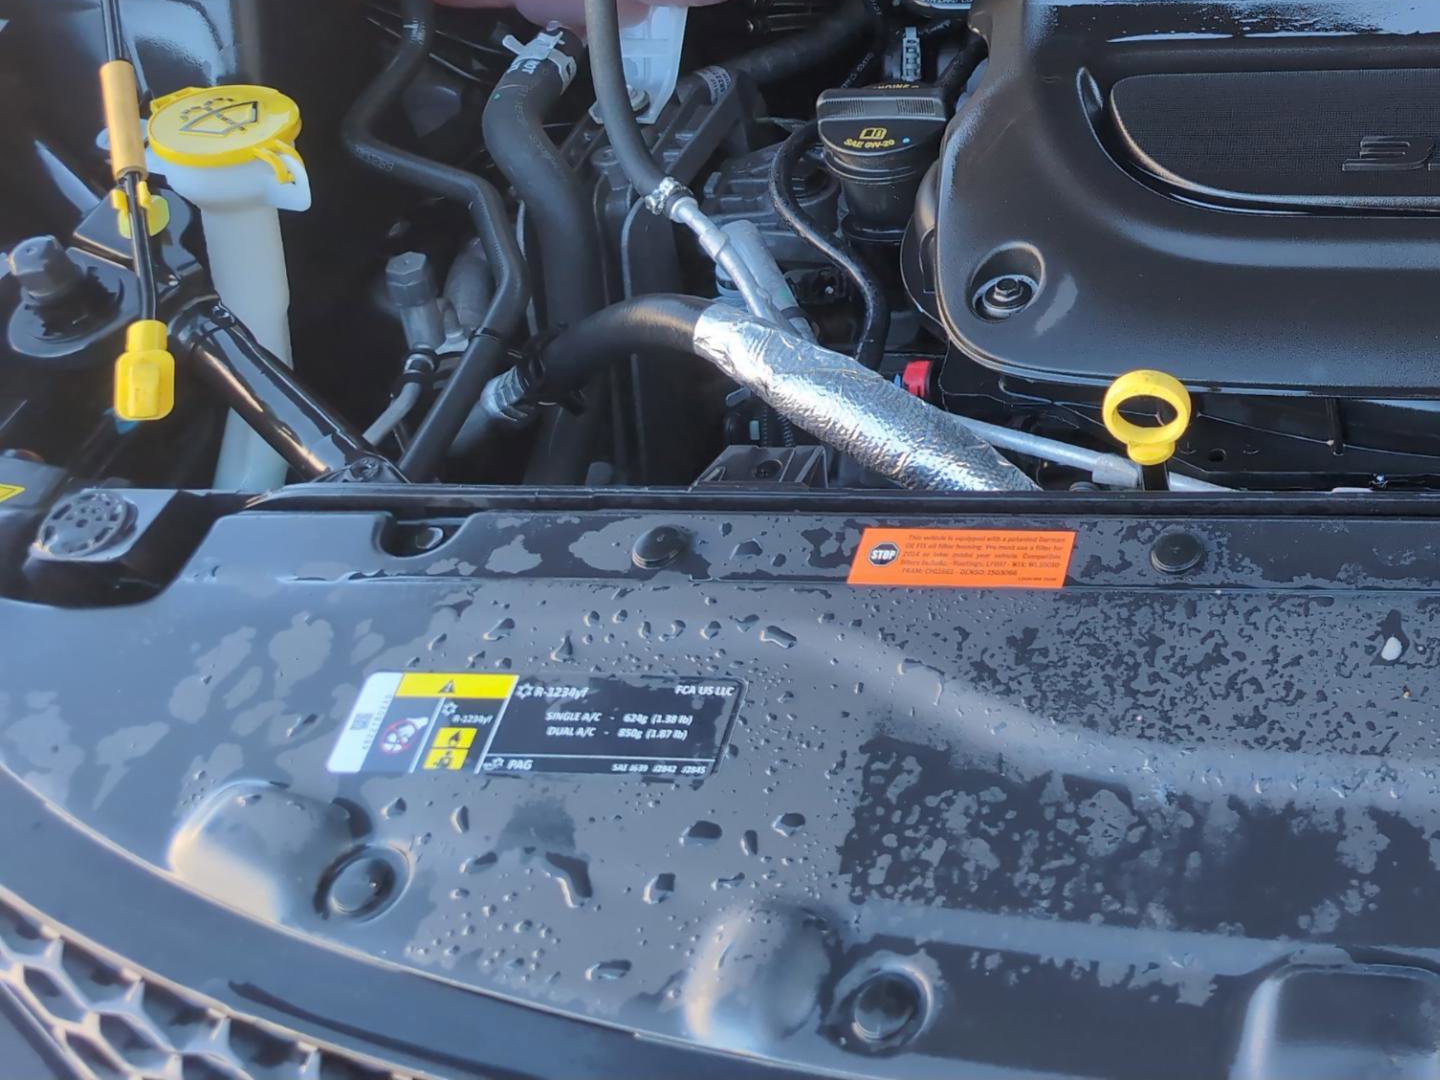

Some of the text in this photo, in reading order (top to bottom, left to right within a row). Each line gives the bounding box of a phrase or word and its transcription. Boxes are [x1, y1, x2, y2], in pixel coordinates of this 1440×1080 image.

[843, 138, 865, 149] SAE
[870, 549, 896, 560] STOP
[533, 686, 590, 700] R-1234yf
[674, 685, 735, 697] FCA US LLC
[545, 711, 581, 722] SINGLE
[581, 712, 603, 723] A/C
[623, 713, 649, 725] 624g
[650, 714, 678, 725] (1.38
[678, 715, 694, 726] lb)
[545, 726, 574, 737] DUAL
[575, 726, 597, 737] A/C
[645, 728, 672, 740] (1.87
[672, 729, 689, 741] lb)
[506, 758, 534, 770] PAG
[611, 763, 629, 772] SAE
